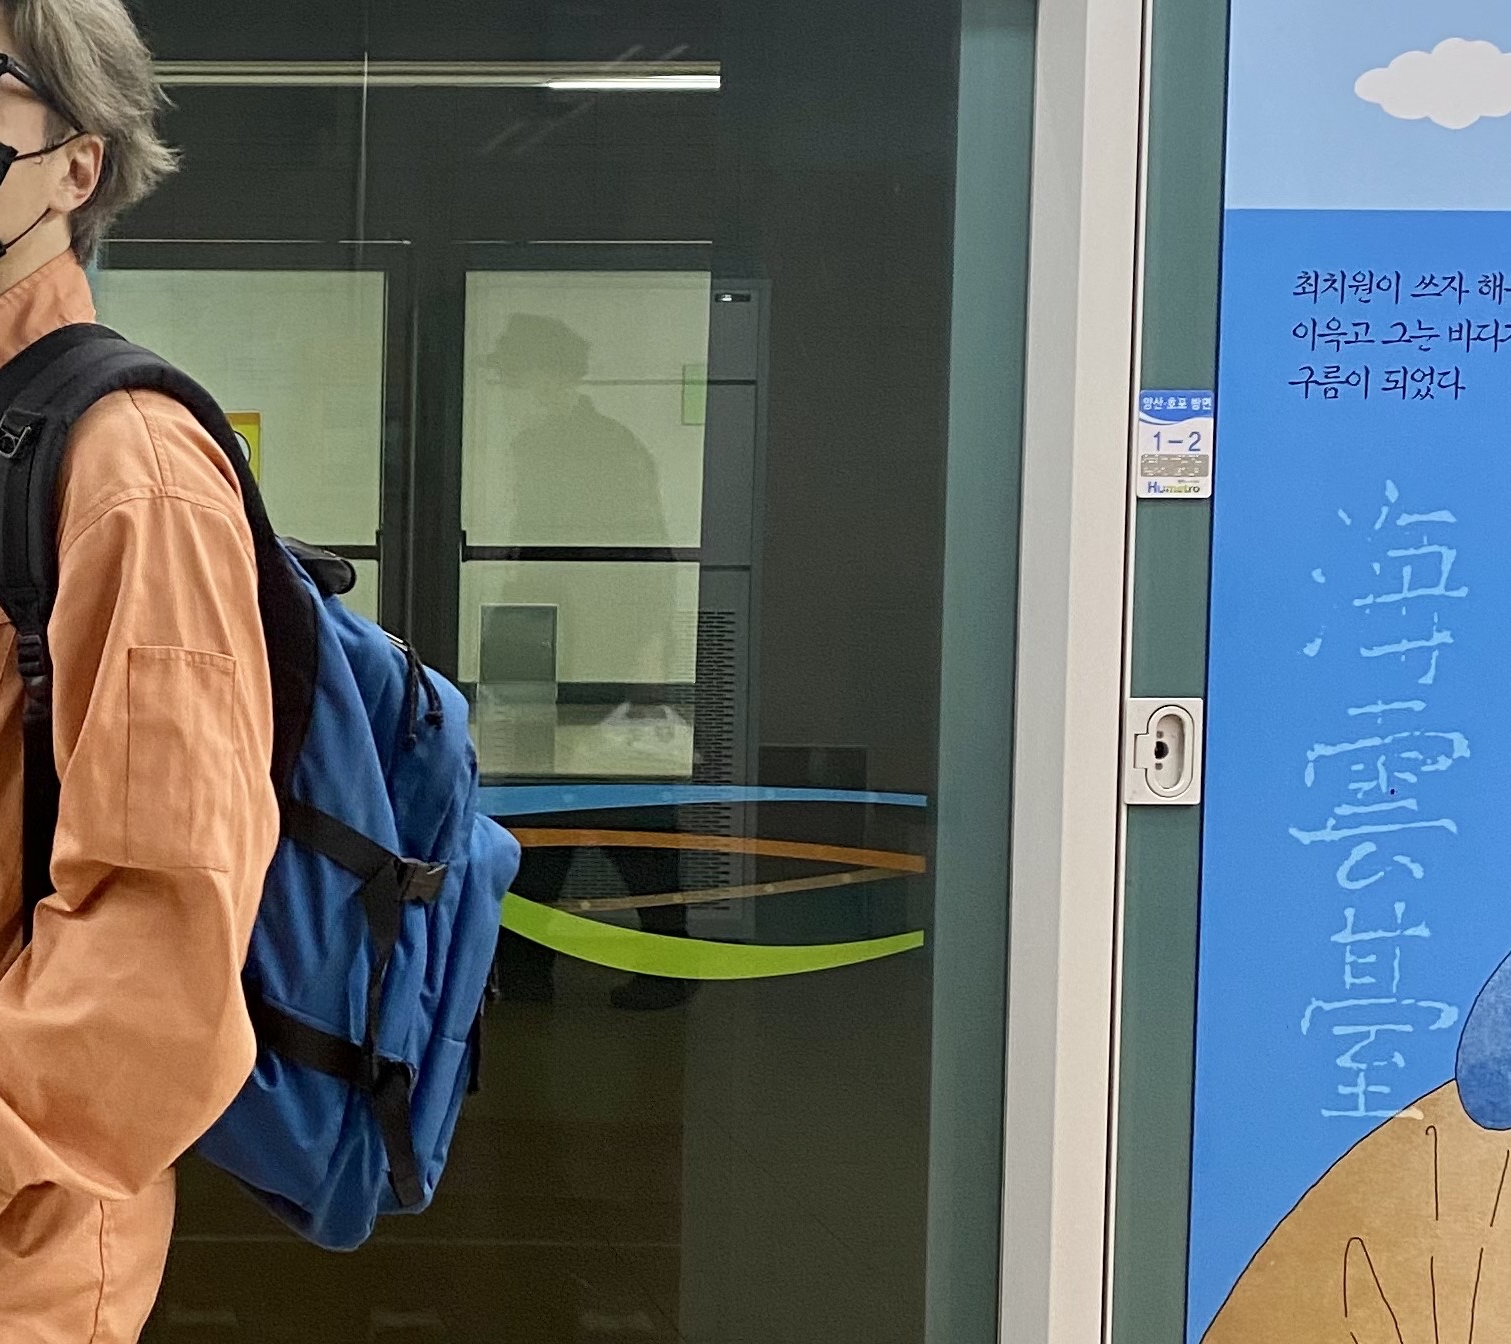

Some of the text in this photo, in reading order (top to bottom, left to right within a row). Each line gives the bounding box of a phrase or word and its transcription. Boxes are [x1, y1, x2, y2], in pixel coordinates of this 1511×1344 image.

[1292, 269, 1402, 304] 최치원이
[1410, 270, 1470, 305] 쓰자
[1292, 316, 1376, 352] 이윽고
[1288, 365, 1466, 401] 구름이 되었다
